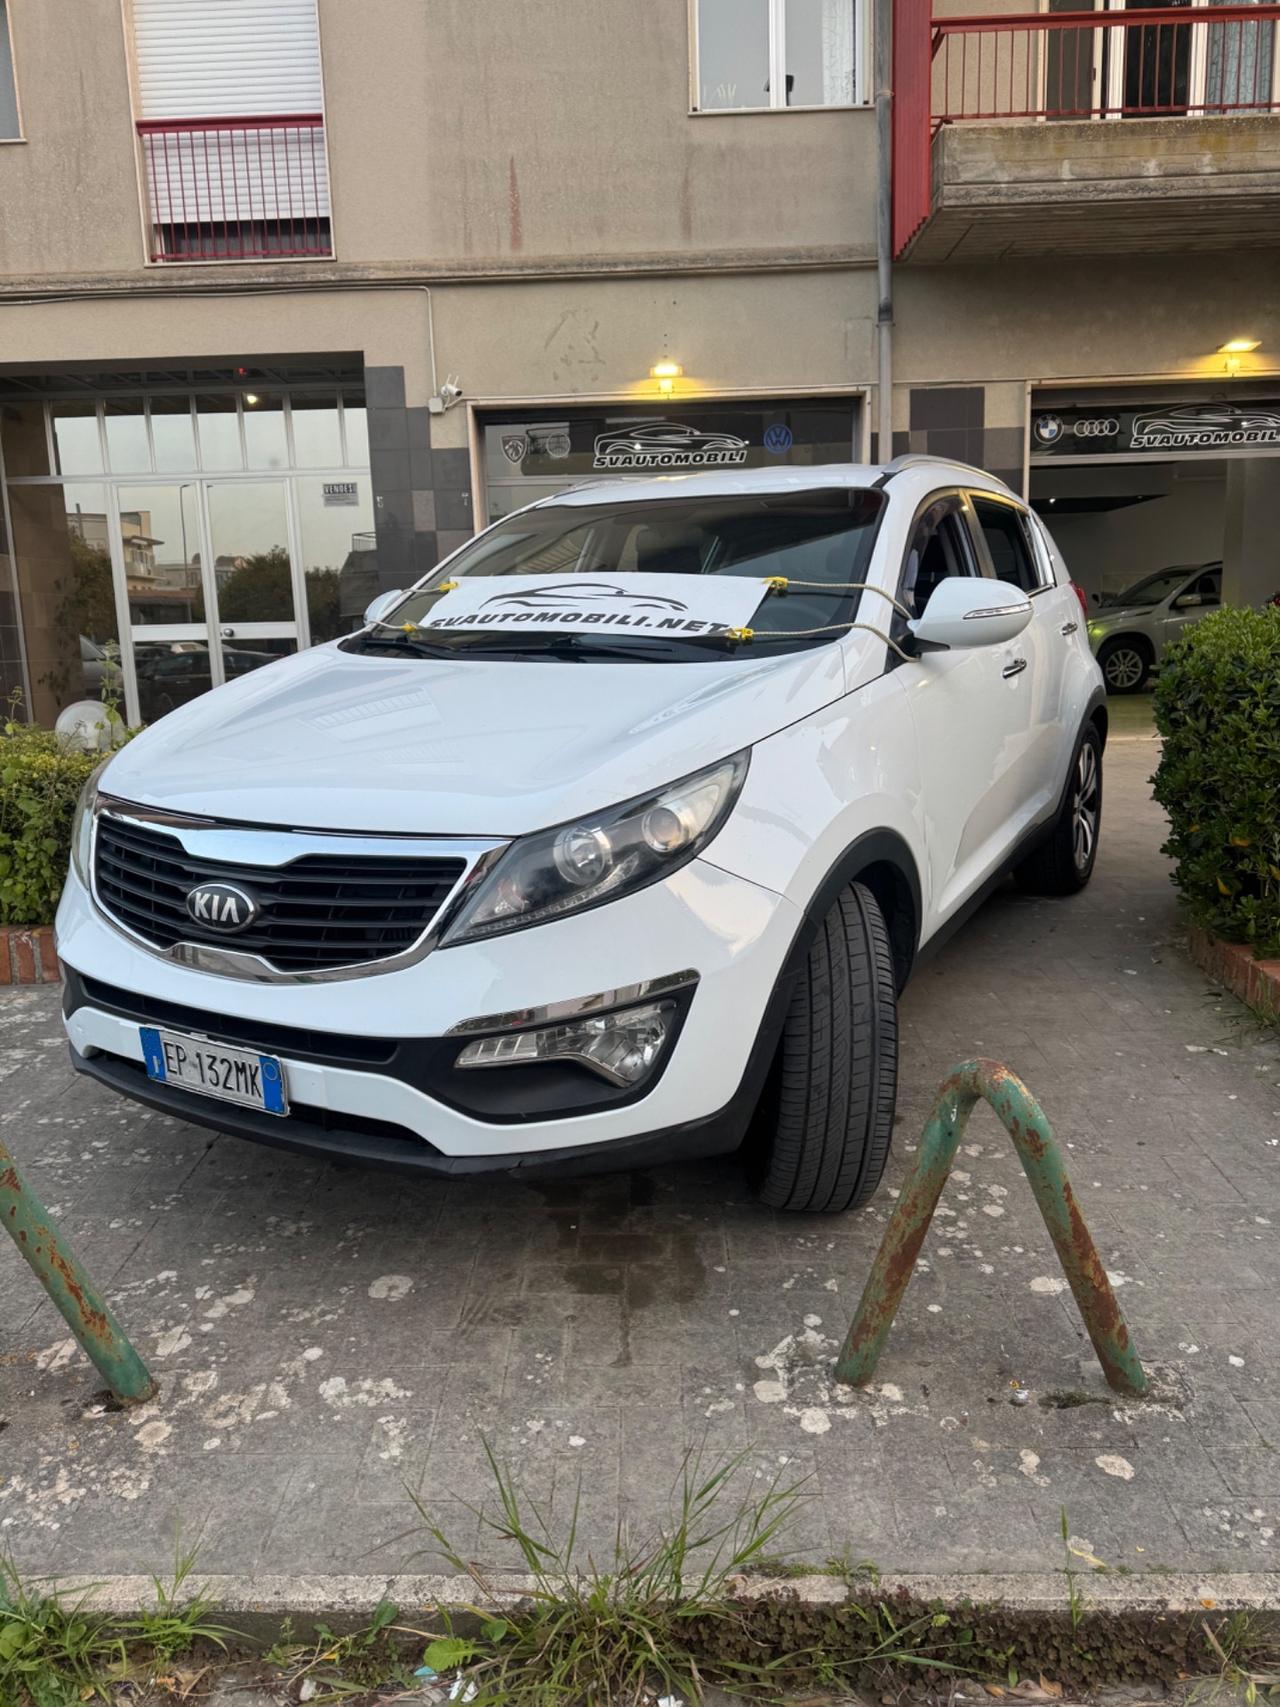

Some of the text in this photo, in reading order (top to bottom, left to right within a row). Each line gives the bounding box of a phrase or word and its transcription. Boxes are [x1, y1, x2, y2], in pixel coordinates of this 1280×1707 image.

[1130, 430, 1280, 448] SVAUTOMOBIL
[593, 451, 746, 468] SVAUTOMOBILI
[429, 611, 730, 633] SVAUTOMOBILI.NET
[195, 892, 240, 923] KIA
